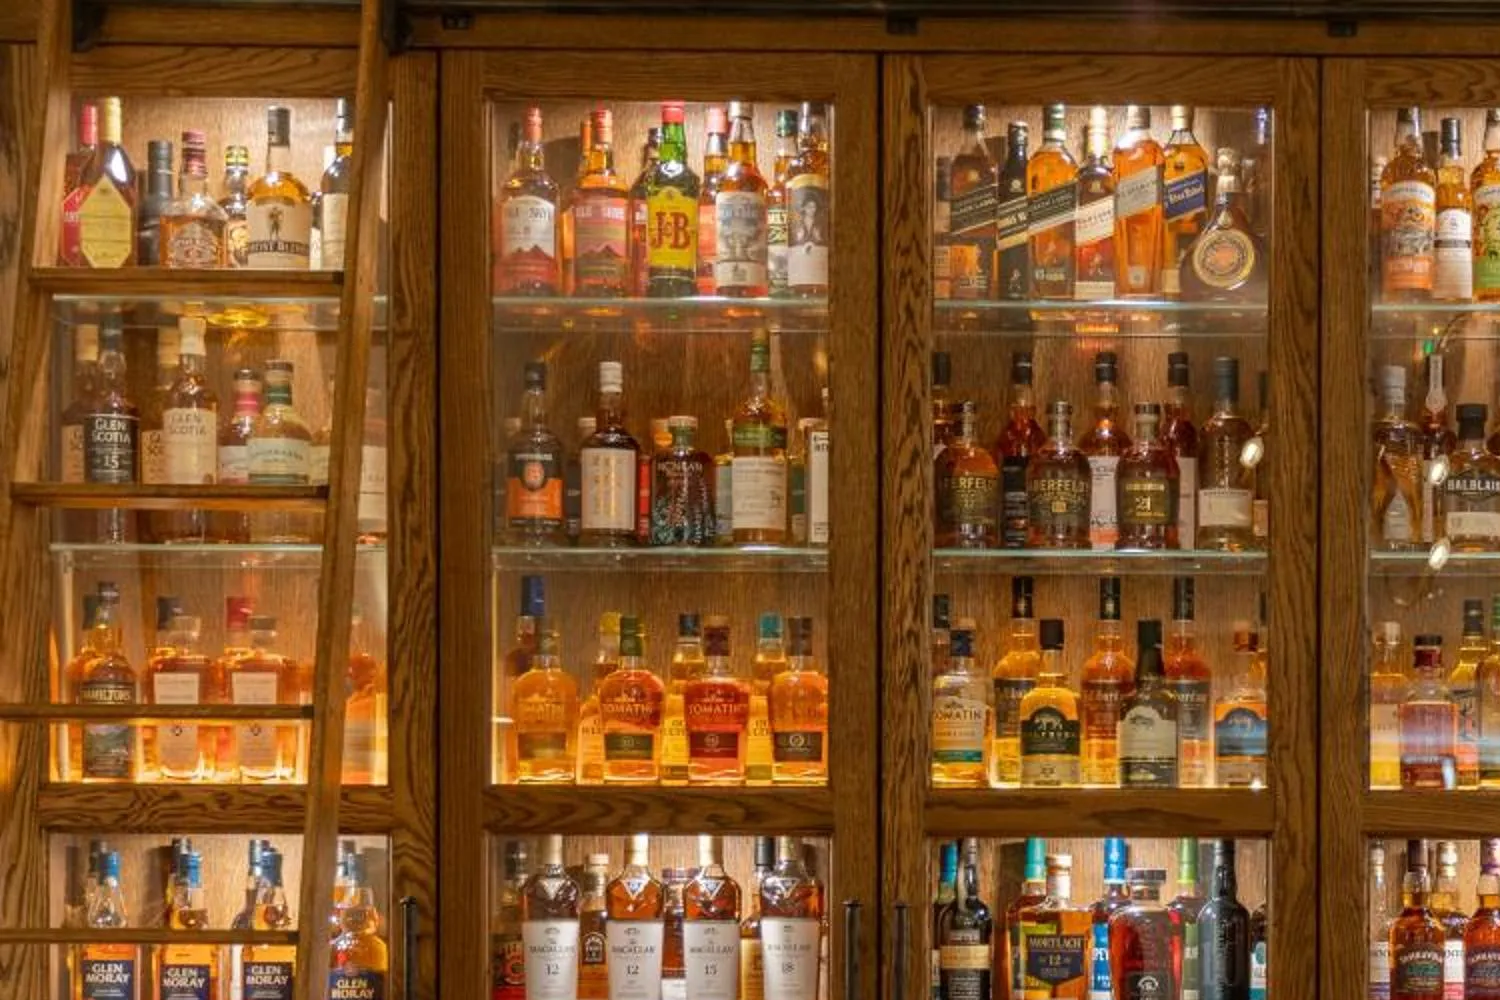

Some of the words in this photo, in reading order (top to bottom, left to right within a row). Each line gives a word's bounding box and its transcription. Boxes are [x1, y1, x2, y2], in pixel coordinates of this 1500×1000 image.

[655, 210, 691, 250] J&B
[94, 418, 126, 430] GLEN
[91, 431, 131, 444] SCOTIA
[103, 456, 120, 470] 15
[1446, 479, 1500, 492] BALBLAIR
[687, 703, 748, 716] TOMATIN
[1028, 935, 1083, 948] MORTLACH
[91, 963, 124, 974] GLEN
[166, 967, 198, 978] GLEN
[251, 965, 282, 976] GLEN
[545, 963, 560, 977] 12
[625, 963, 639, 977] 12
[86, 972, 131, 985] MORAY
[163, 977, 206, 989] MORAY
[245, 975, 288, 987] MORAY
[335, 979, 368, 989] GLEN
[331, 988, 375, 1000] MORAY
